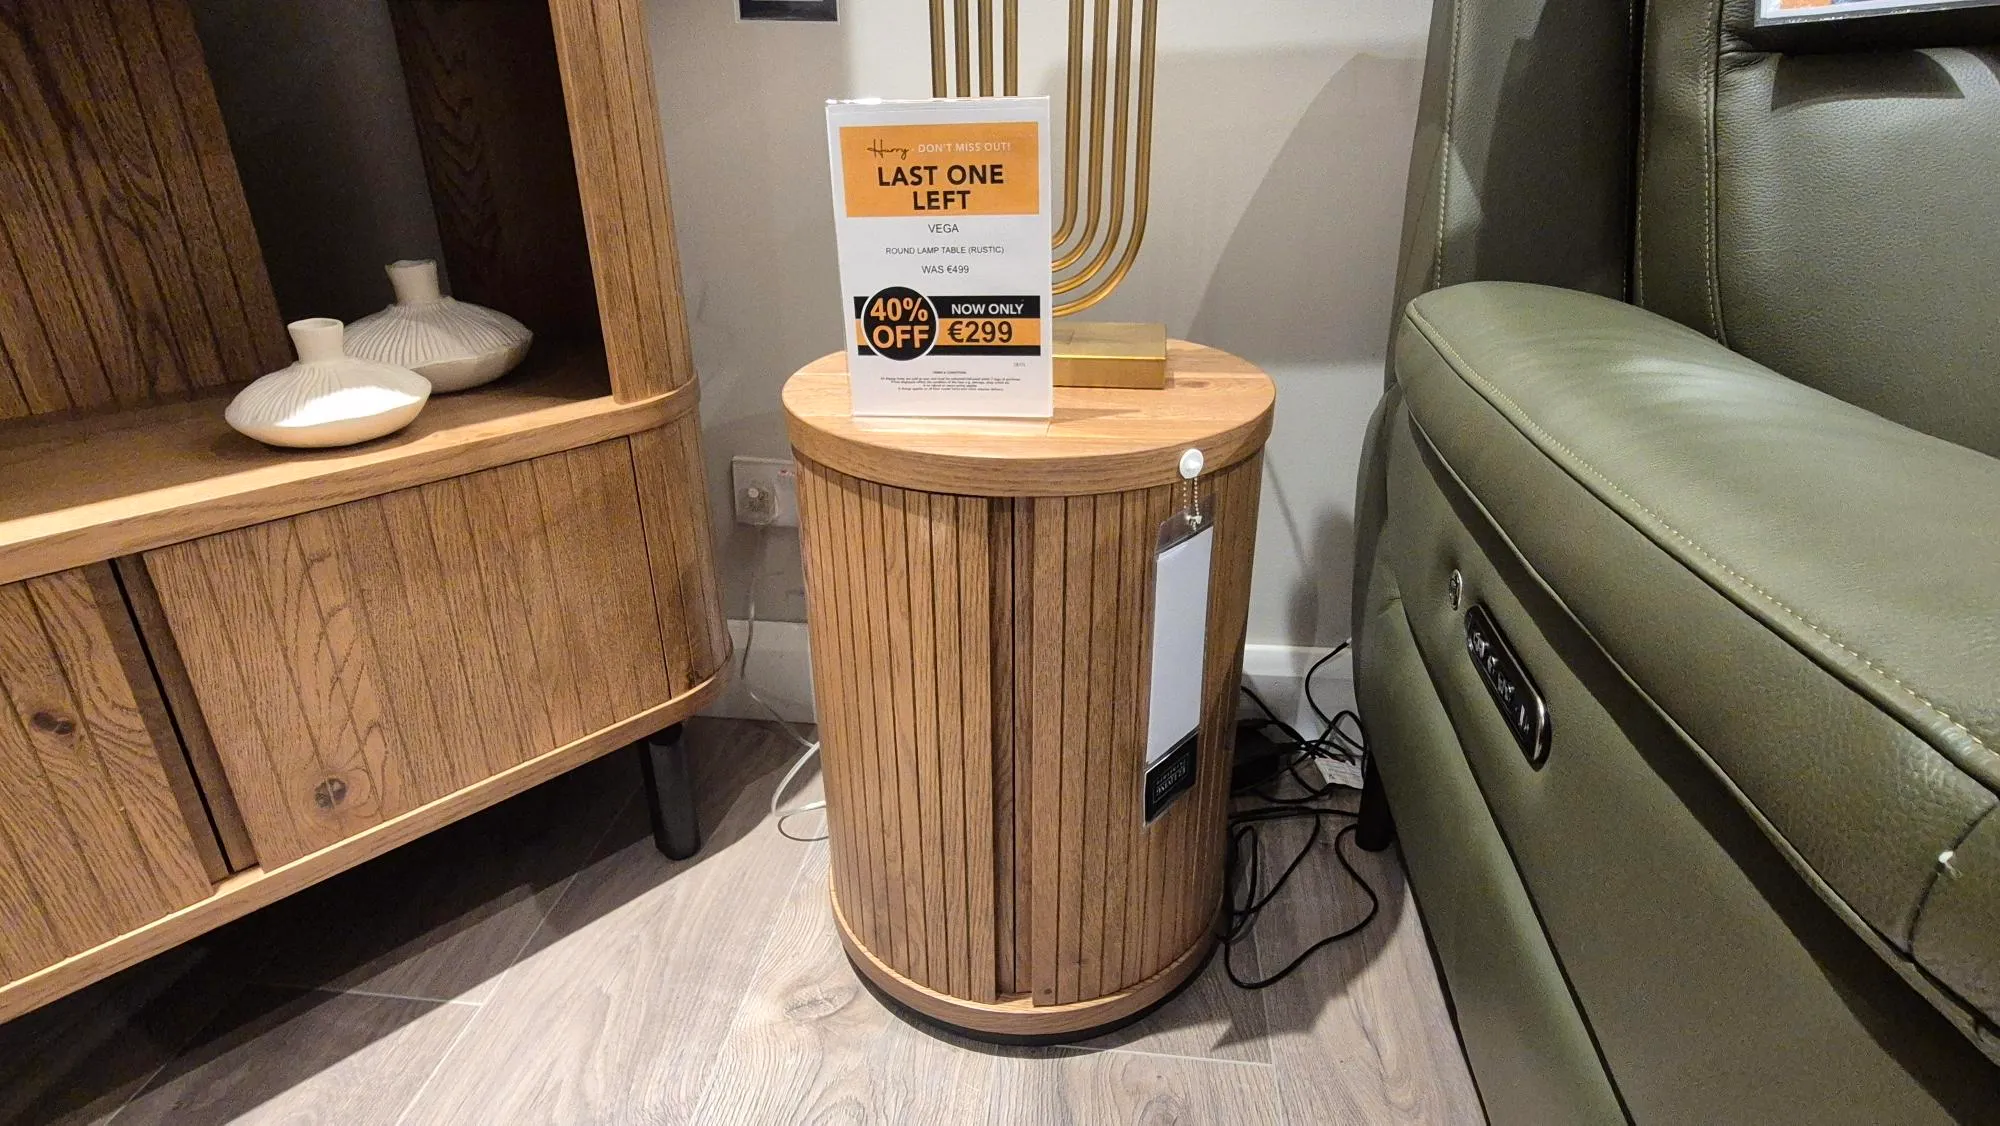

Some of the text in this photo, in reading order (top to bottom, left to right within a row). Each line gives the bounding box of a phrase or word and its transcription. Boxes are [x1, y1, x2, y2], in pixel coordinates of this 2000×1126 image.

[918, 143, 953, 153] DON'T
[955, 143, 981, 152] MISS
[984, 142, 1012, 151] OUT!
[877, 164, 1004, 187] LAST ONE
[913, 190, 970, 210] LEFT
[927, 223, 960, 234] VEGA
[885, 246, 1005, 255] ROUND LAMP TABLE (RUSTIC)
[921, 265, 970, 274] WAS €499
[870, 297, 929, 322] 40%
[951, 303, 1024, 315] NOW ONLY
[872, 325, 930, 349] OFF
[947, 320, 1013, 344] €299
